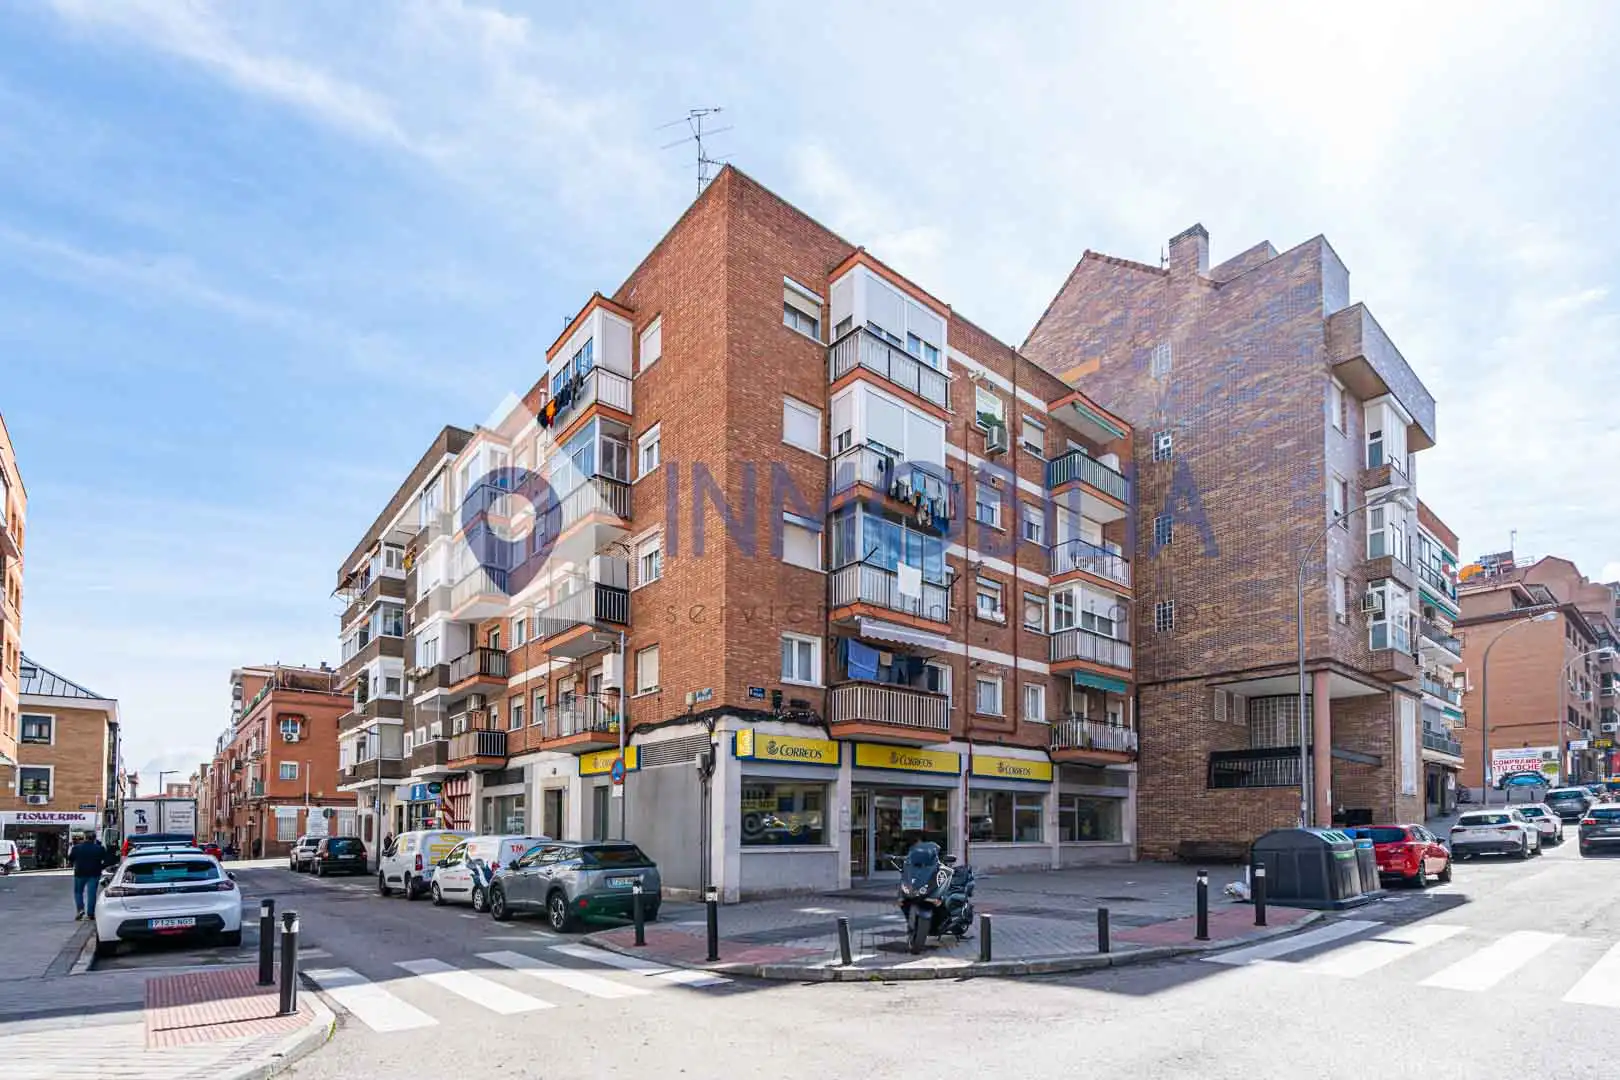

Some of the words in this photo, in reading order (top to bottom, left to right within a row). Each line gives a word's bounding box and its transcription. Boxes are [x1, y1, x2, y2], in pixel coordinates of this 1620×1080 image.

[780, 744, 822, 759] CORREOS
[900, 754, 933, 767] CORREOS
[16, 812, 86, 821] FLOWERING
